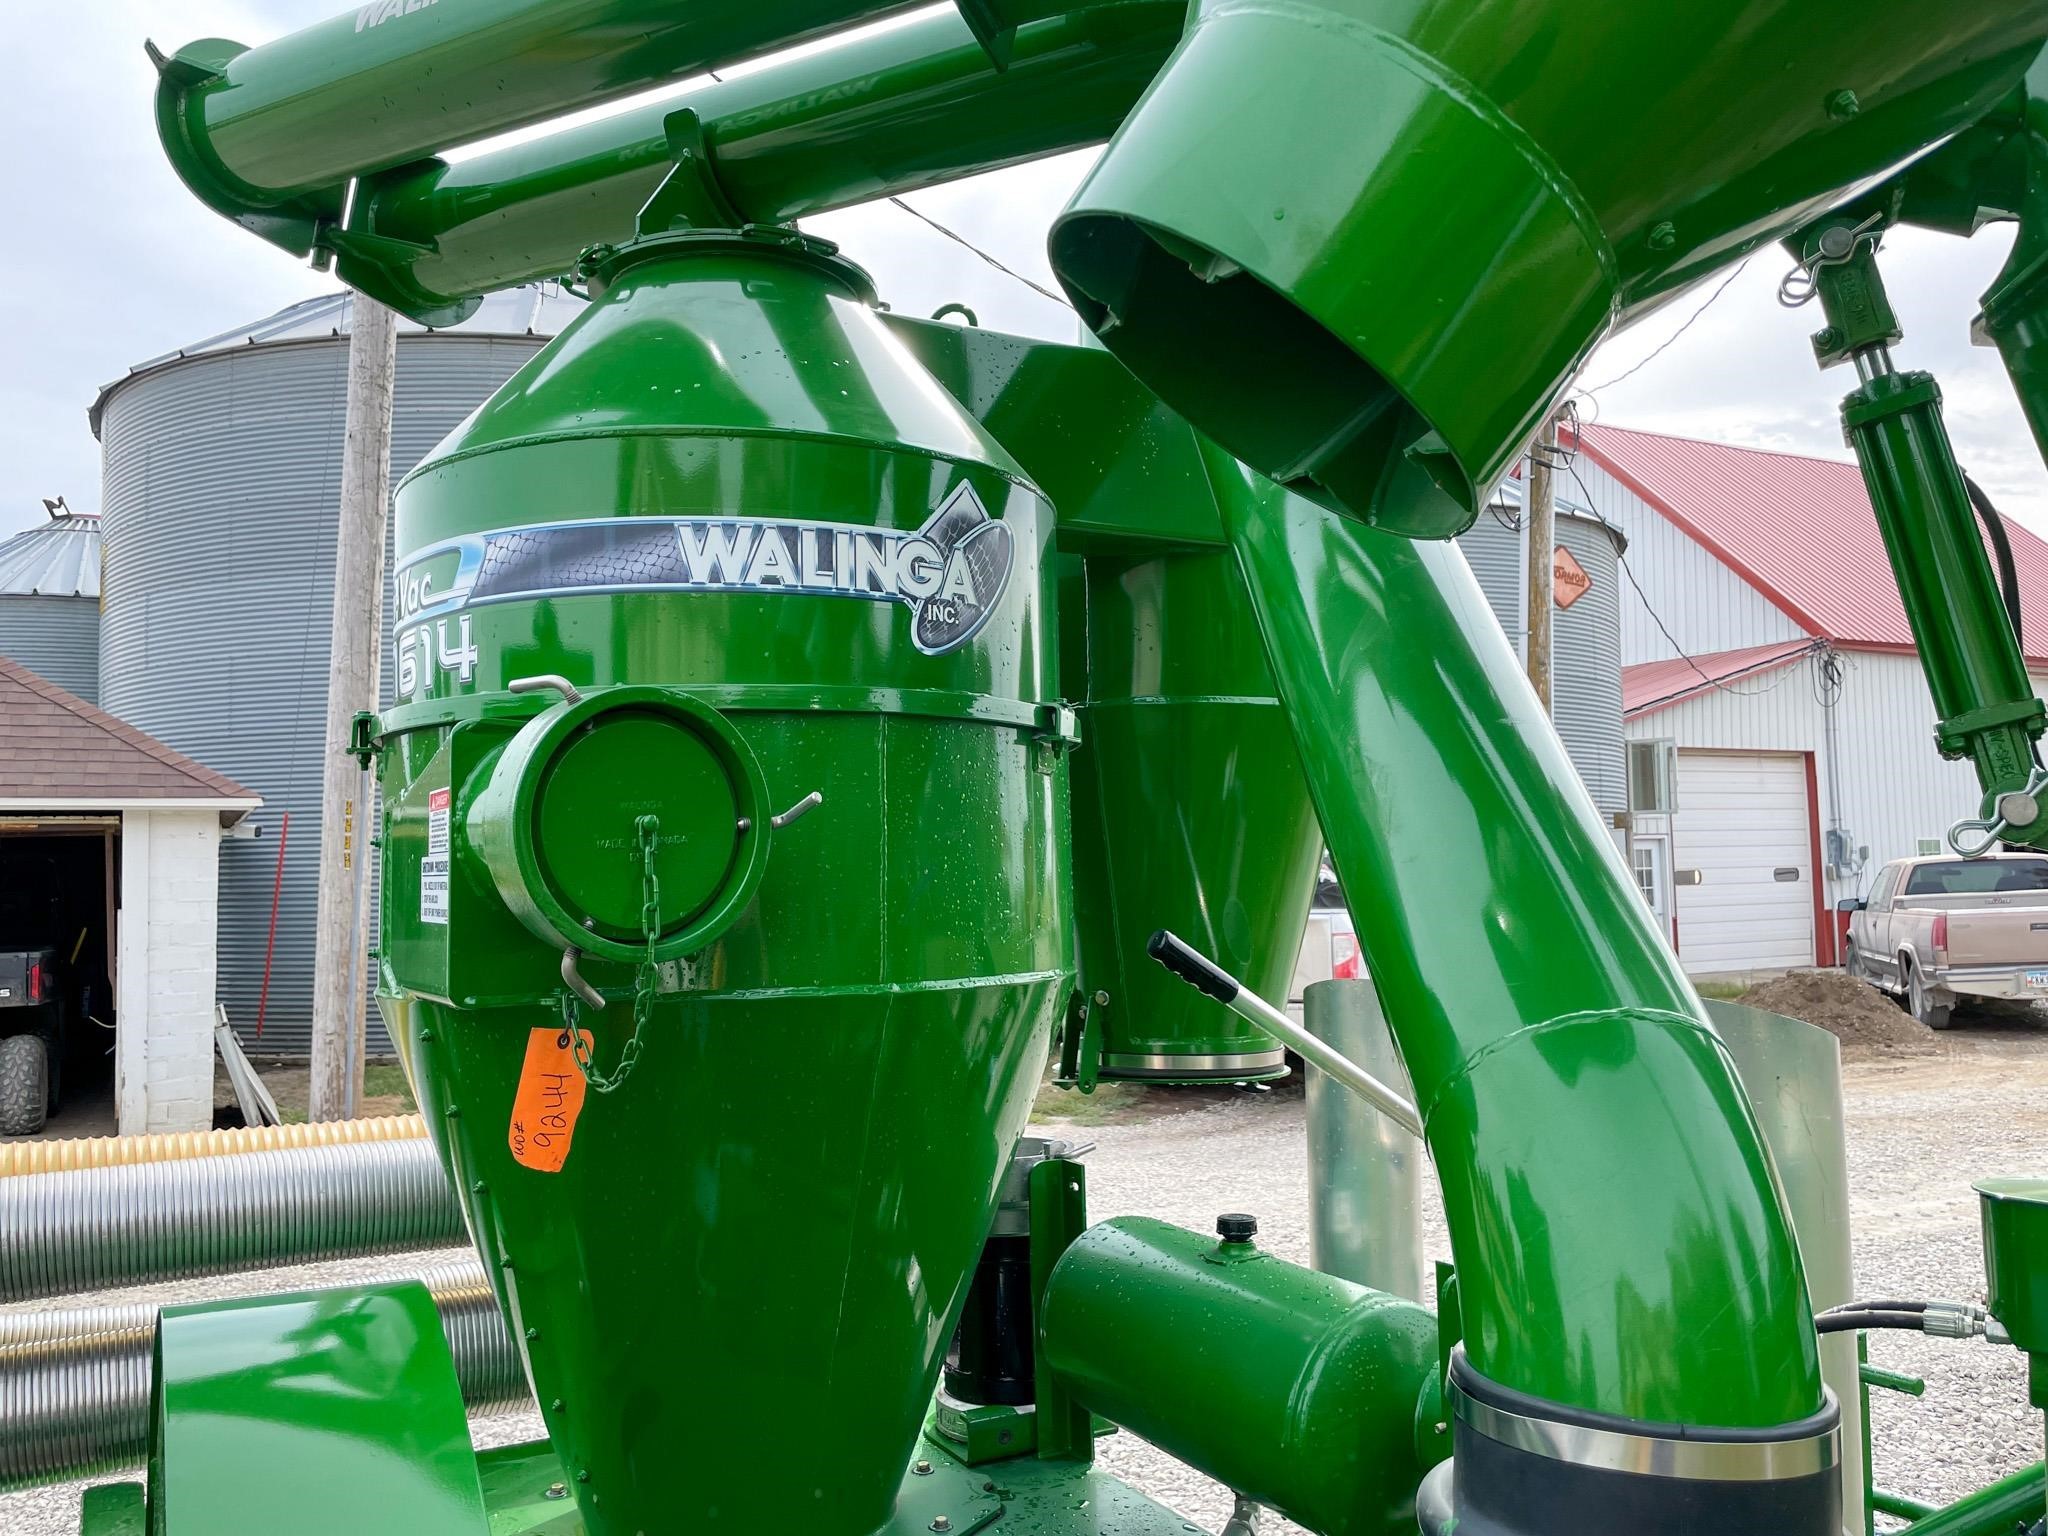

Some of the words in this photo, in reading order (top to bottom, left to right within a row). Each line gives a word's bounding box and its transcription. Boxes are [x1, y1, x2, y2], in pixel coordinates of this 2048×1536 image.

[676, 522, 982, 606] WALINGA
[928, 603, 960, 625] INC.
[394, 614, 478, 699] 1614
[533, 1073, 573, 1148] 9244
